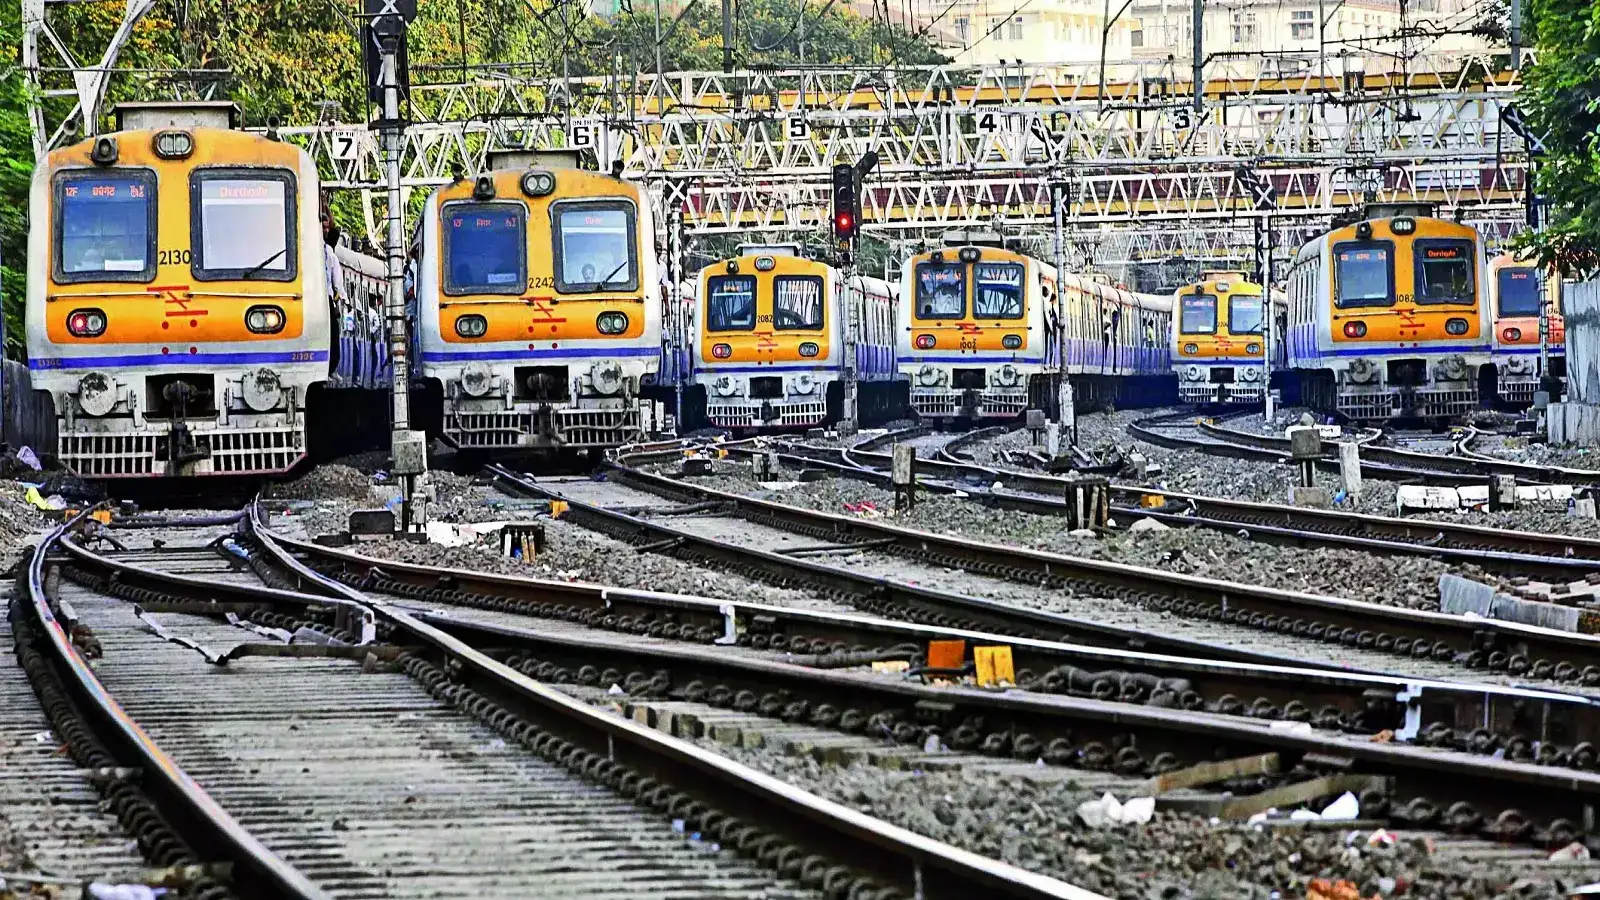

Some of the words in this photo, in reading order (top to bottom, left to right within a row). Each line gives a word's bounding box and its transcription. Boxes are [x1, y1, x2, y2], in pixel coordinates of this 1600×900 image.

[791, 118, 806, 137] 5
[979, 114, 997, 132] 4
[573, 127, 590, 145] 6
[338, 137, 353, 157] 7
[159, 250, 192, 265] 2130
[528, 277, 555, 289] 2242
[1396, 294, 1415, 303] 1082
